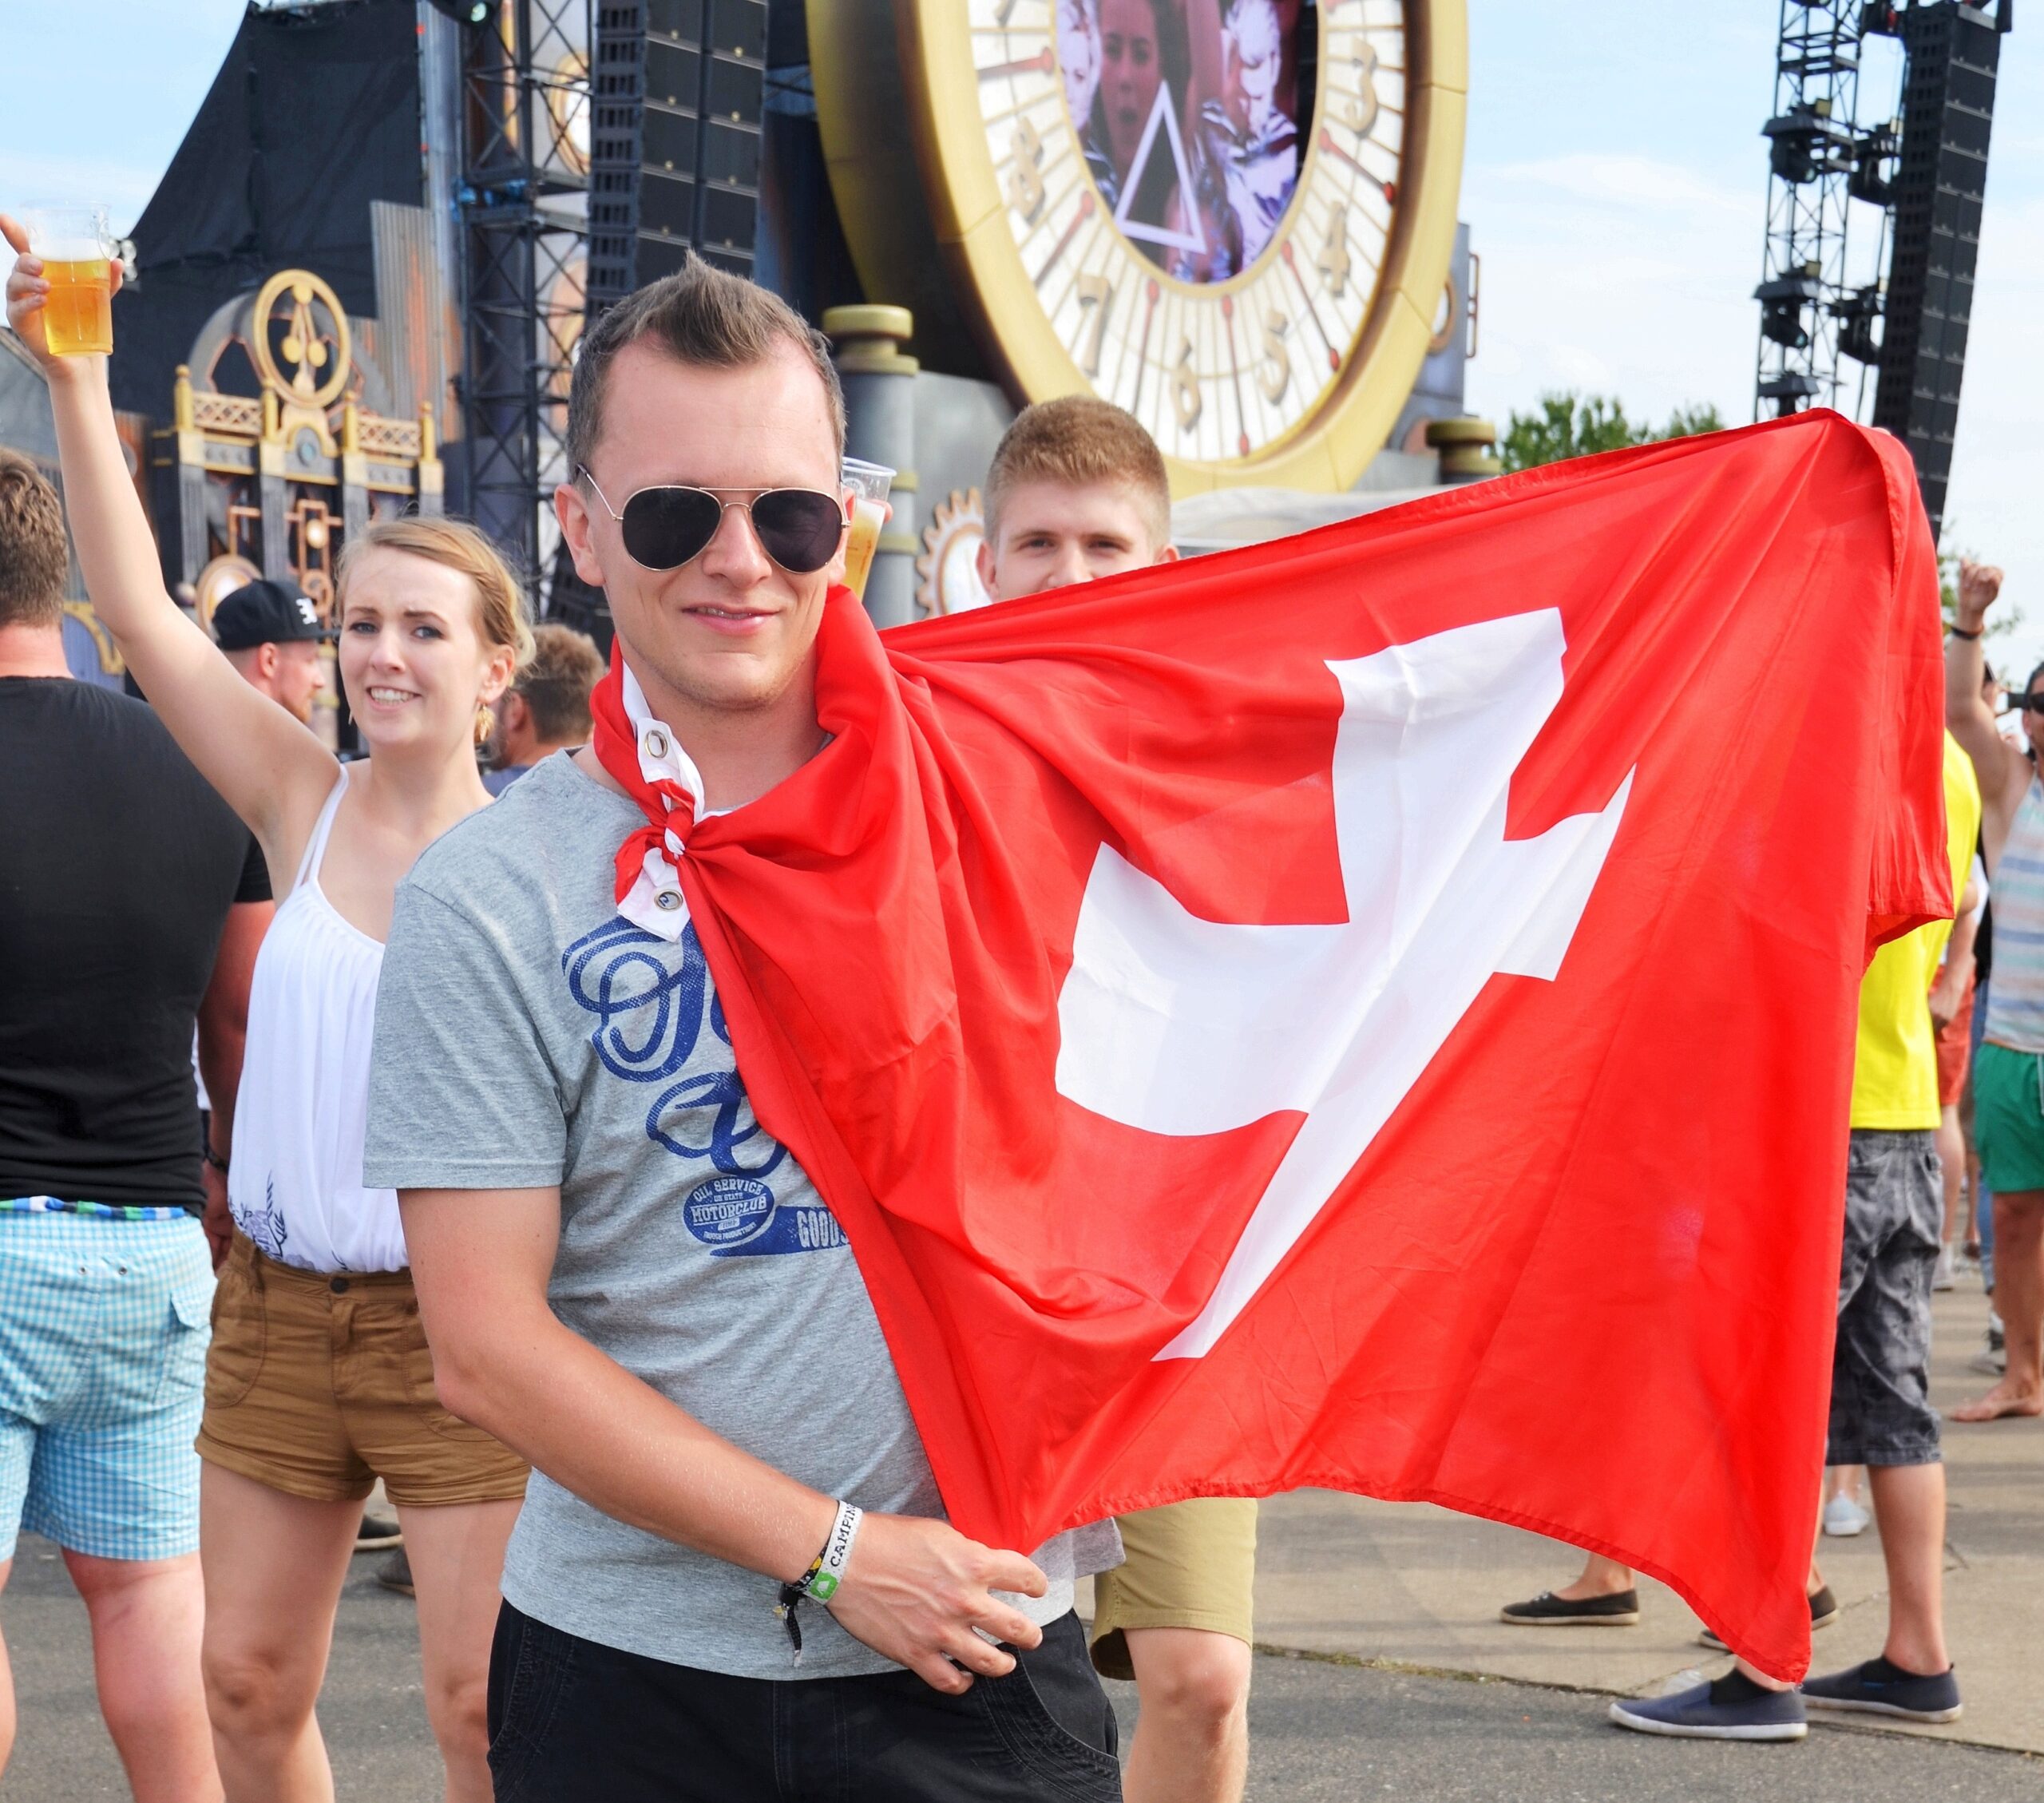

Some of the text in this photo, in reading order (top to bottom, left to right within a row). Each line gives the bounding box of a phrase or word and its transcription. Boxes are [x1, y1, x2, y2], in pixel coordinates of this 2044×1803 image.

[1317, 200, 1350, 298] 4
[1078, 274, 1112, 377] 7
[1258, 307, 1289, 406] 5
[1171, 335, 1202, 434] 6
[691, 1195, 767, 1222] MOTORCLUB
[693, 1178, 764, 1202] OIL SERVICE
[830, 1504, 856, 1567] CAMPIN
